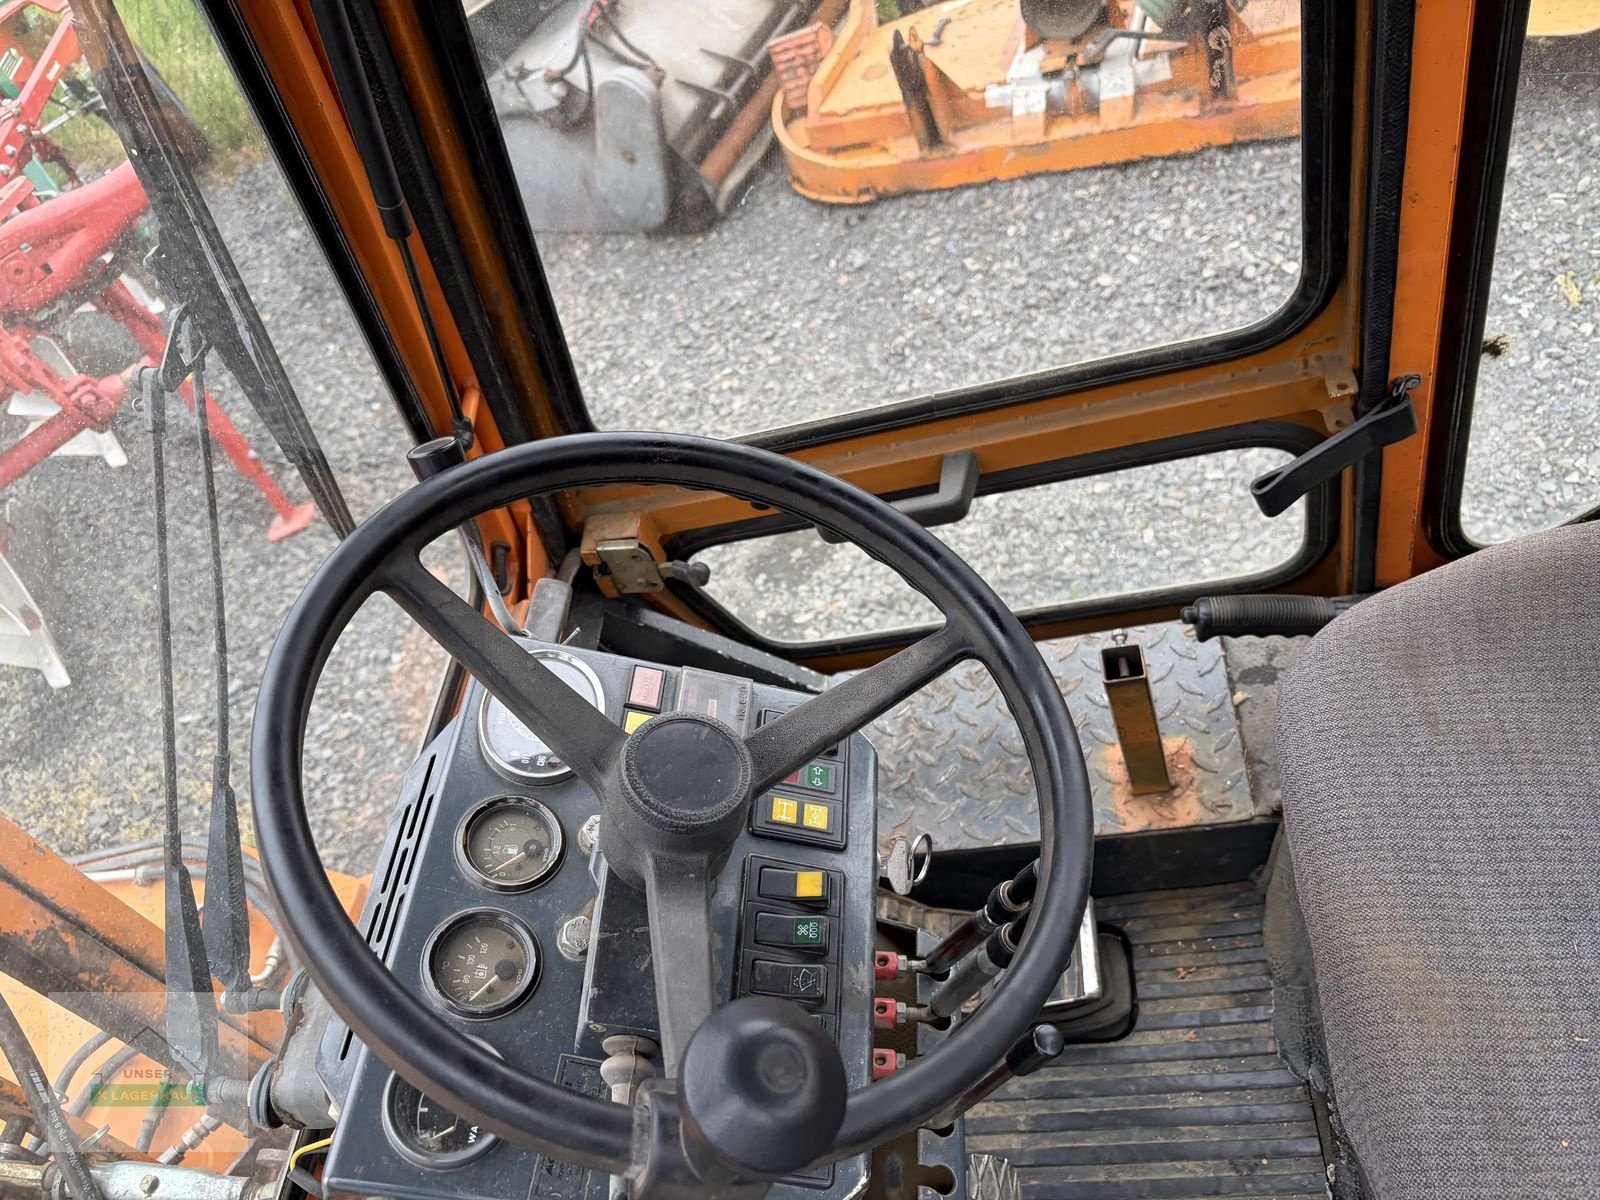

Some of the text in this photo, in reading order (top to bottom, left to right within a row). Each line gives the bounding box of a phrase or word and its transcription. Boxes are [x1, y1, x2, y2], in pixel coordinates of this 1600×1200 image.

[480, 942, 489, 954] 120
[466, 954, 476, 966] 100
[49, 1108, 61, 1124] bar
